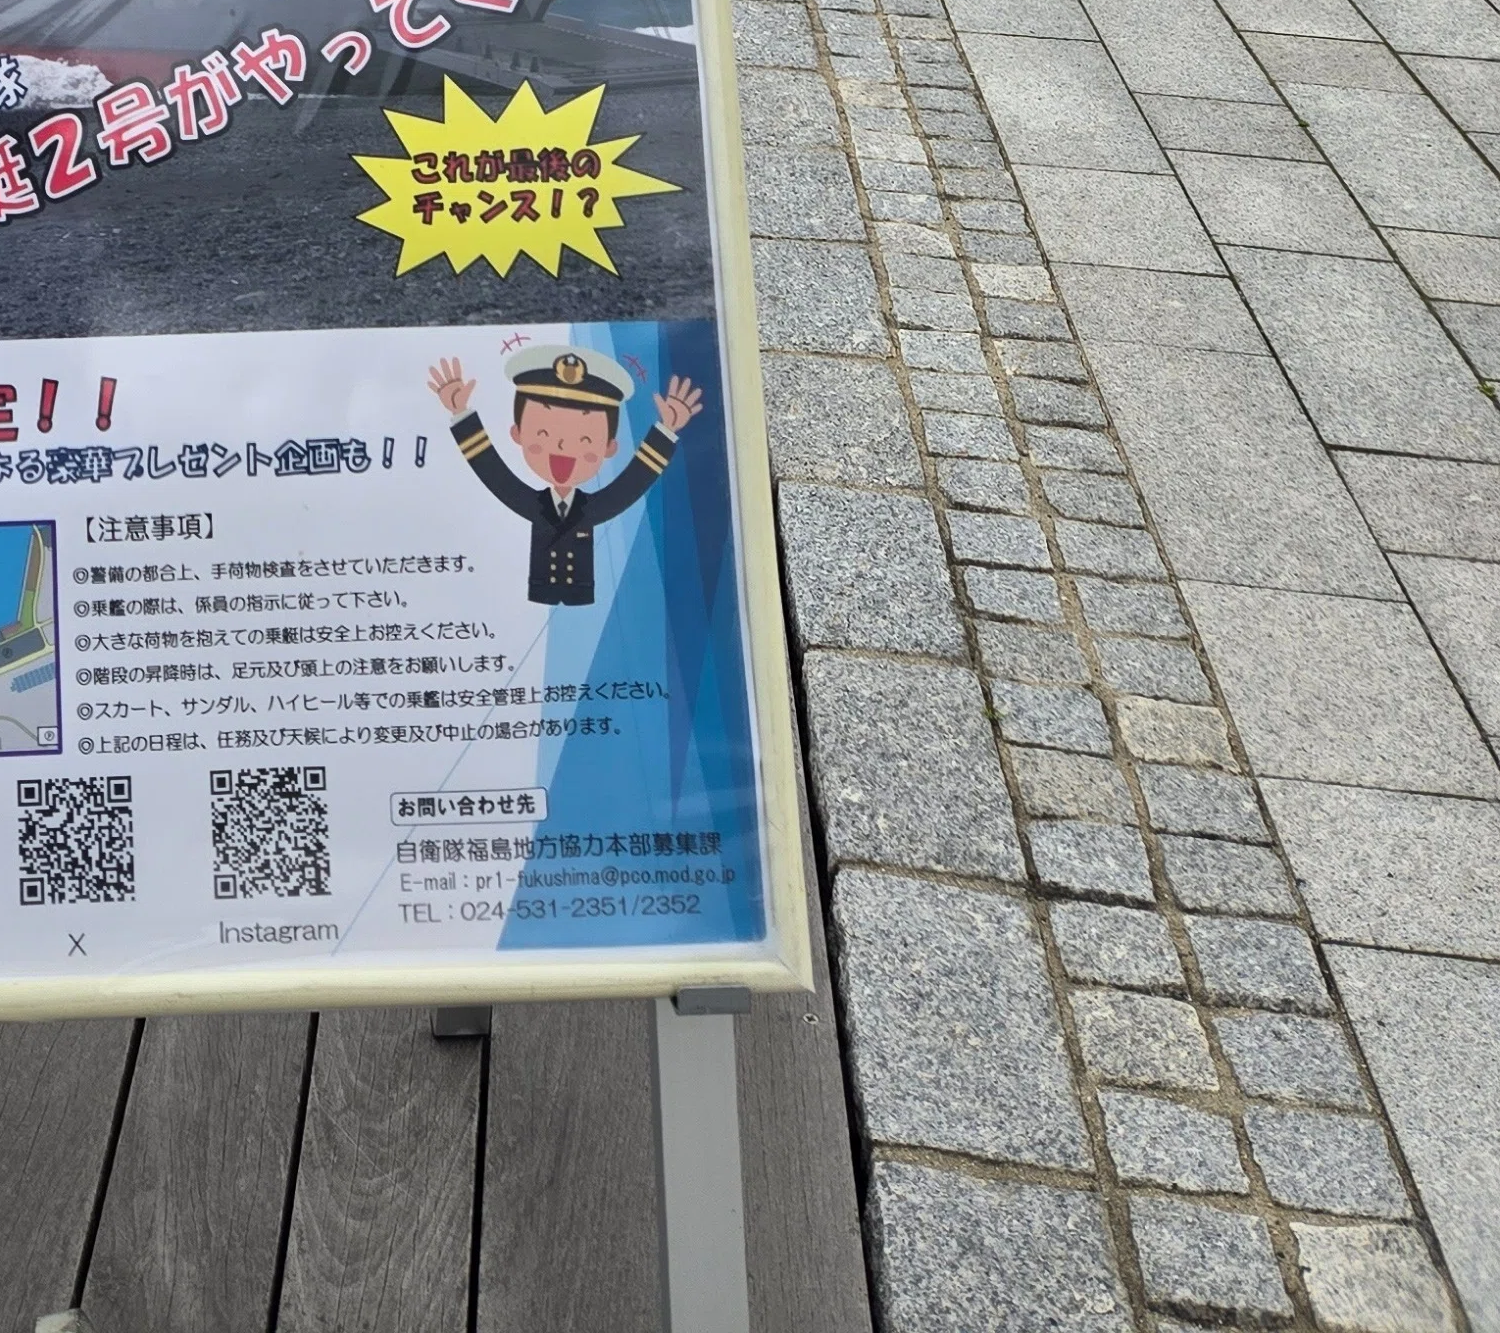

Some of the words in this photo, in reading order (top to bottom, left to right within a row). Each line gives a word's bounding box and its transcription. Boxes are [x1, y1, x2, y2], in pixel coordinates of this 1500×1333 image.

[411, 148, 600, 183] これが最後の
[85, 512, 214, 543] 【注意事項】
[398, 793, 536, 818] お問い合わせ先
[396, 832, 723, 864] 自衛隊福島地方協力本部募集課
[68, 933, 88, 957] X
[219, 920, 339, 945] Instagram
